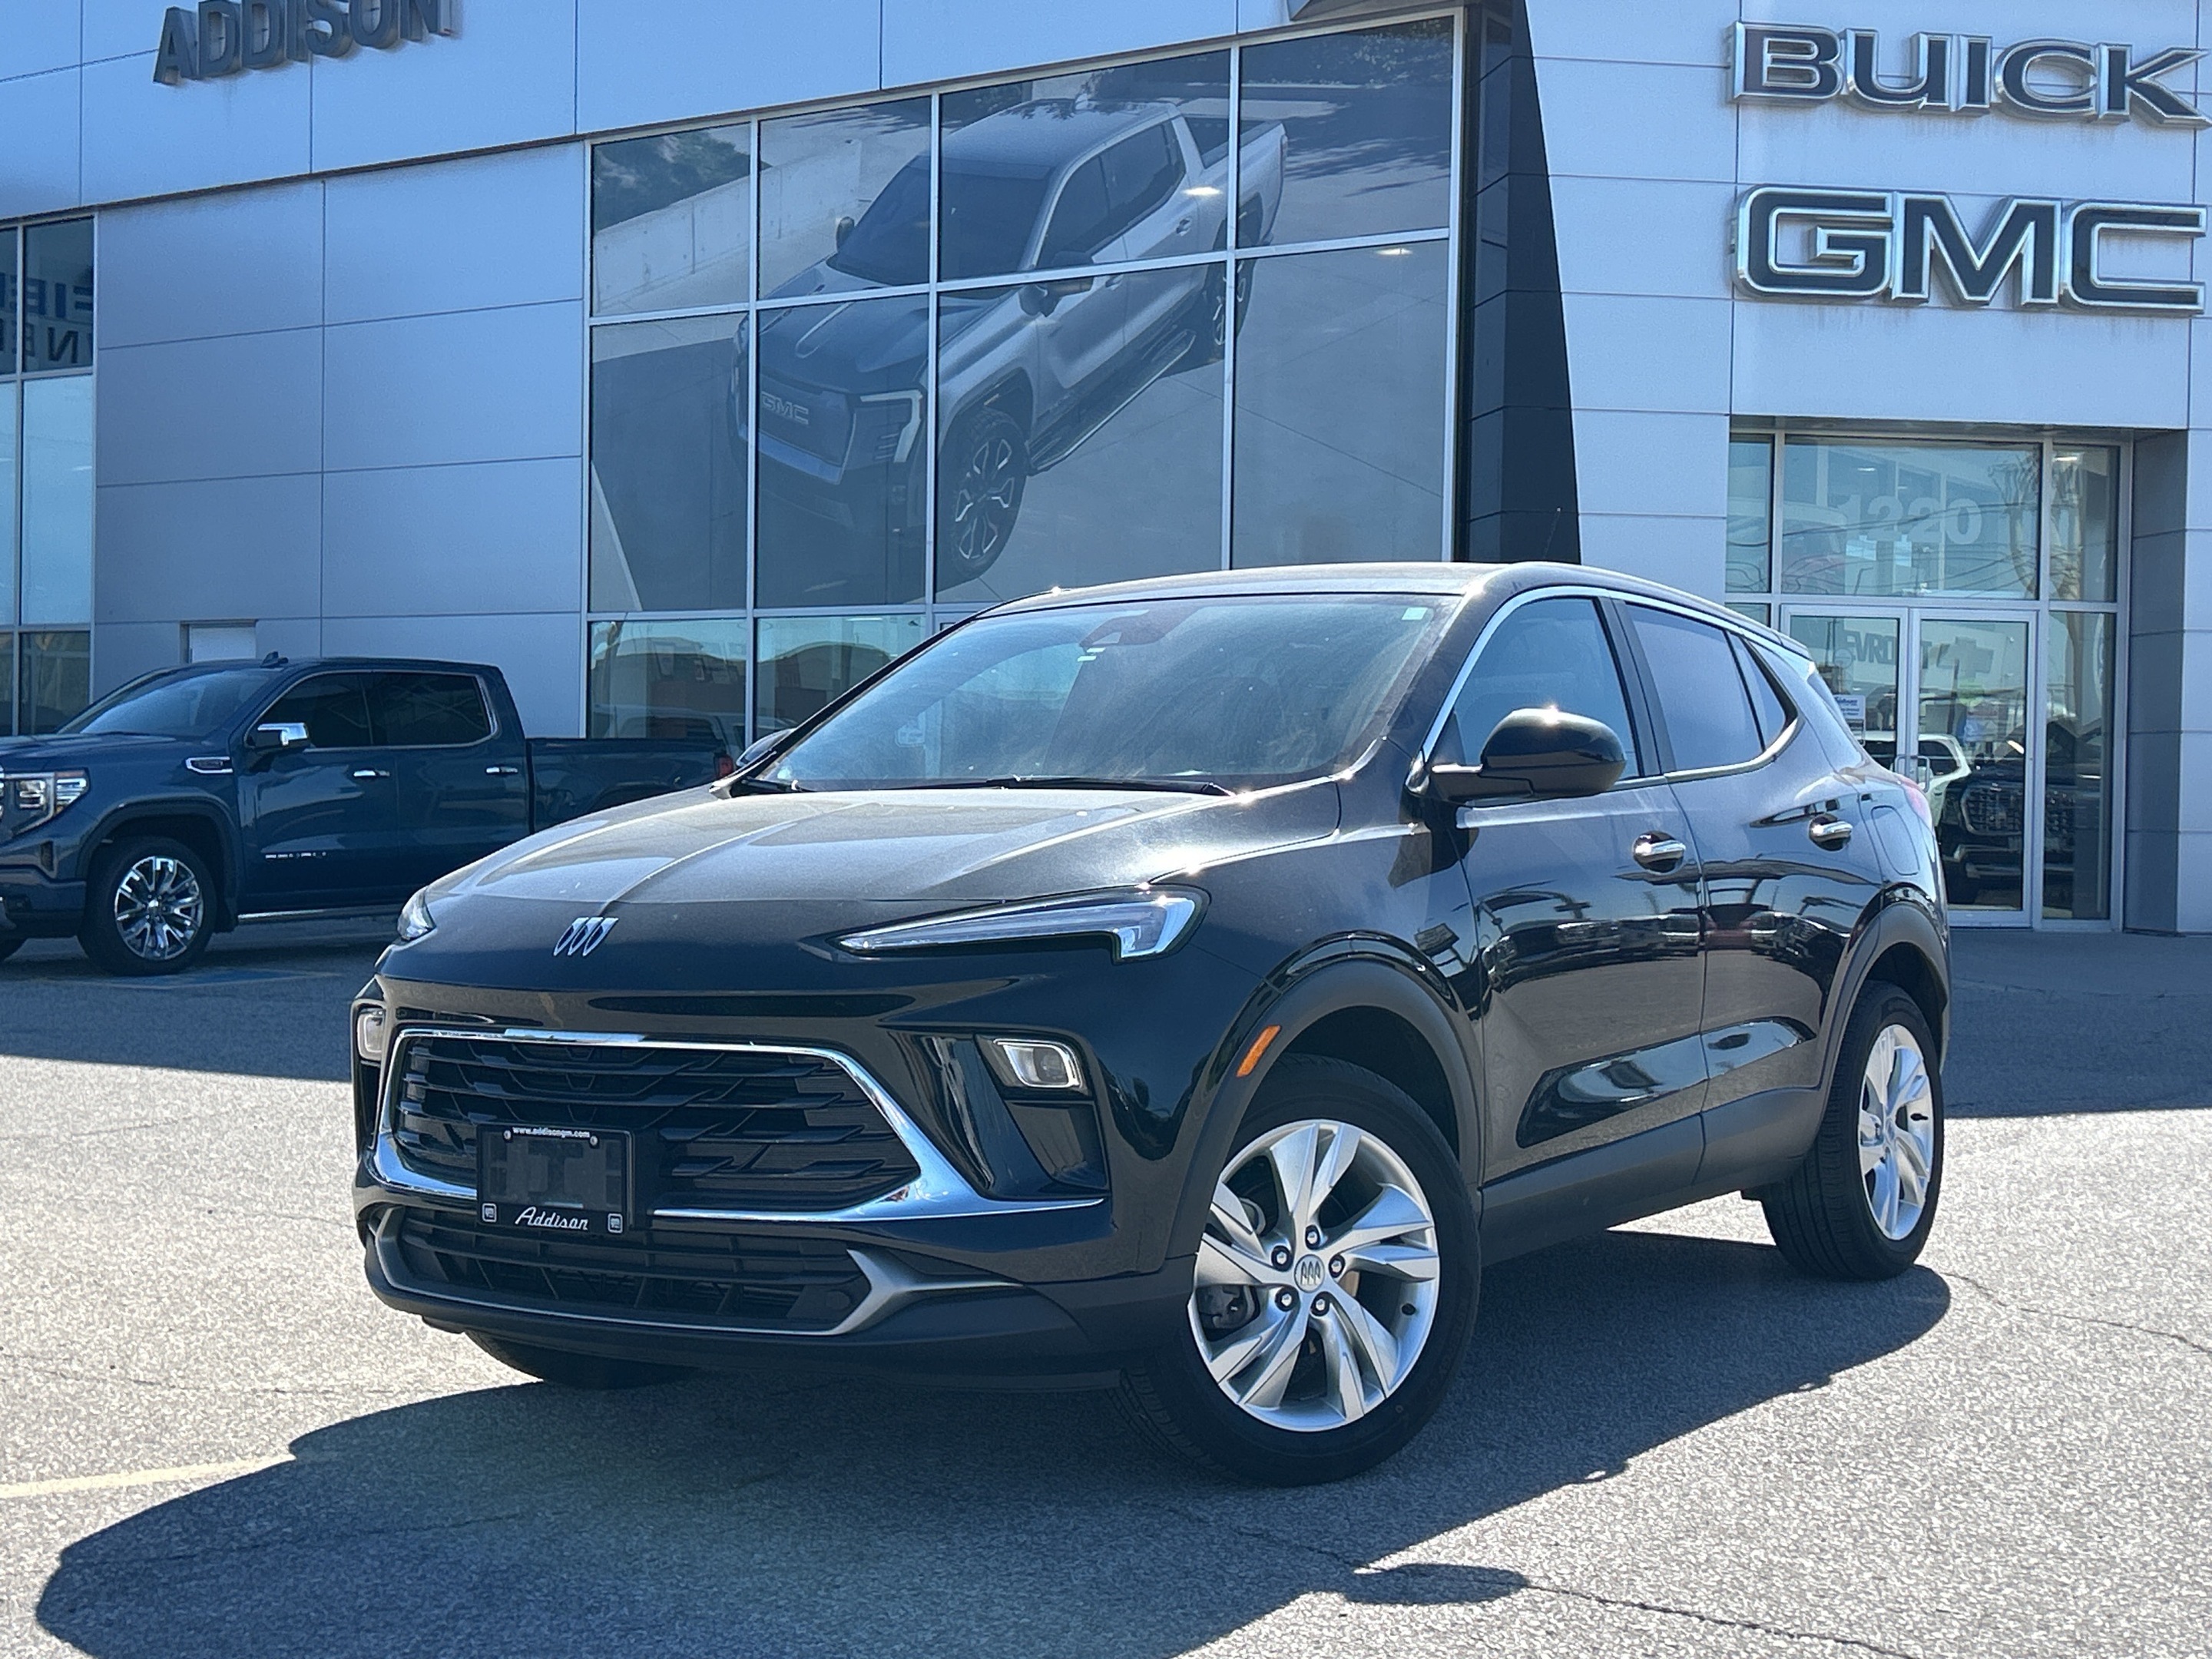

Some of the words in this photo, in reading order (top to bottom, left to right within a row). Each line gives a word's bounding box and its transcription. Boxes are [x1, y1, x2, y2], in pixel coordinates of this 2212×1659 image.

[154, 0, 458, 84] ADDISON
[1728, 21, 2212, 128] BUICK
[1731, 184, 2209, 316] GMC
[760, 390, 809, 425] GMC
[1838, 494, 1982, 545] 1220
[515, 1207, 588, 1230] Addison
